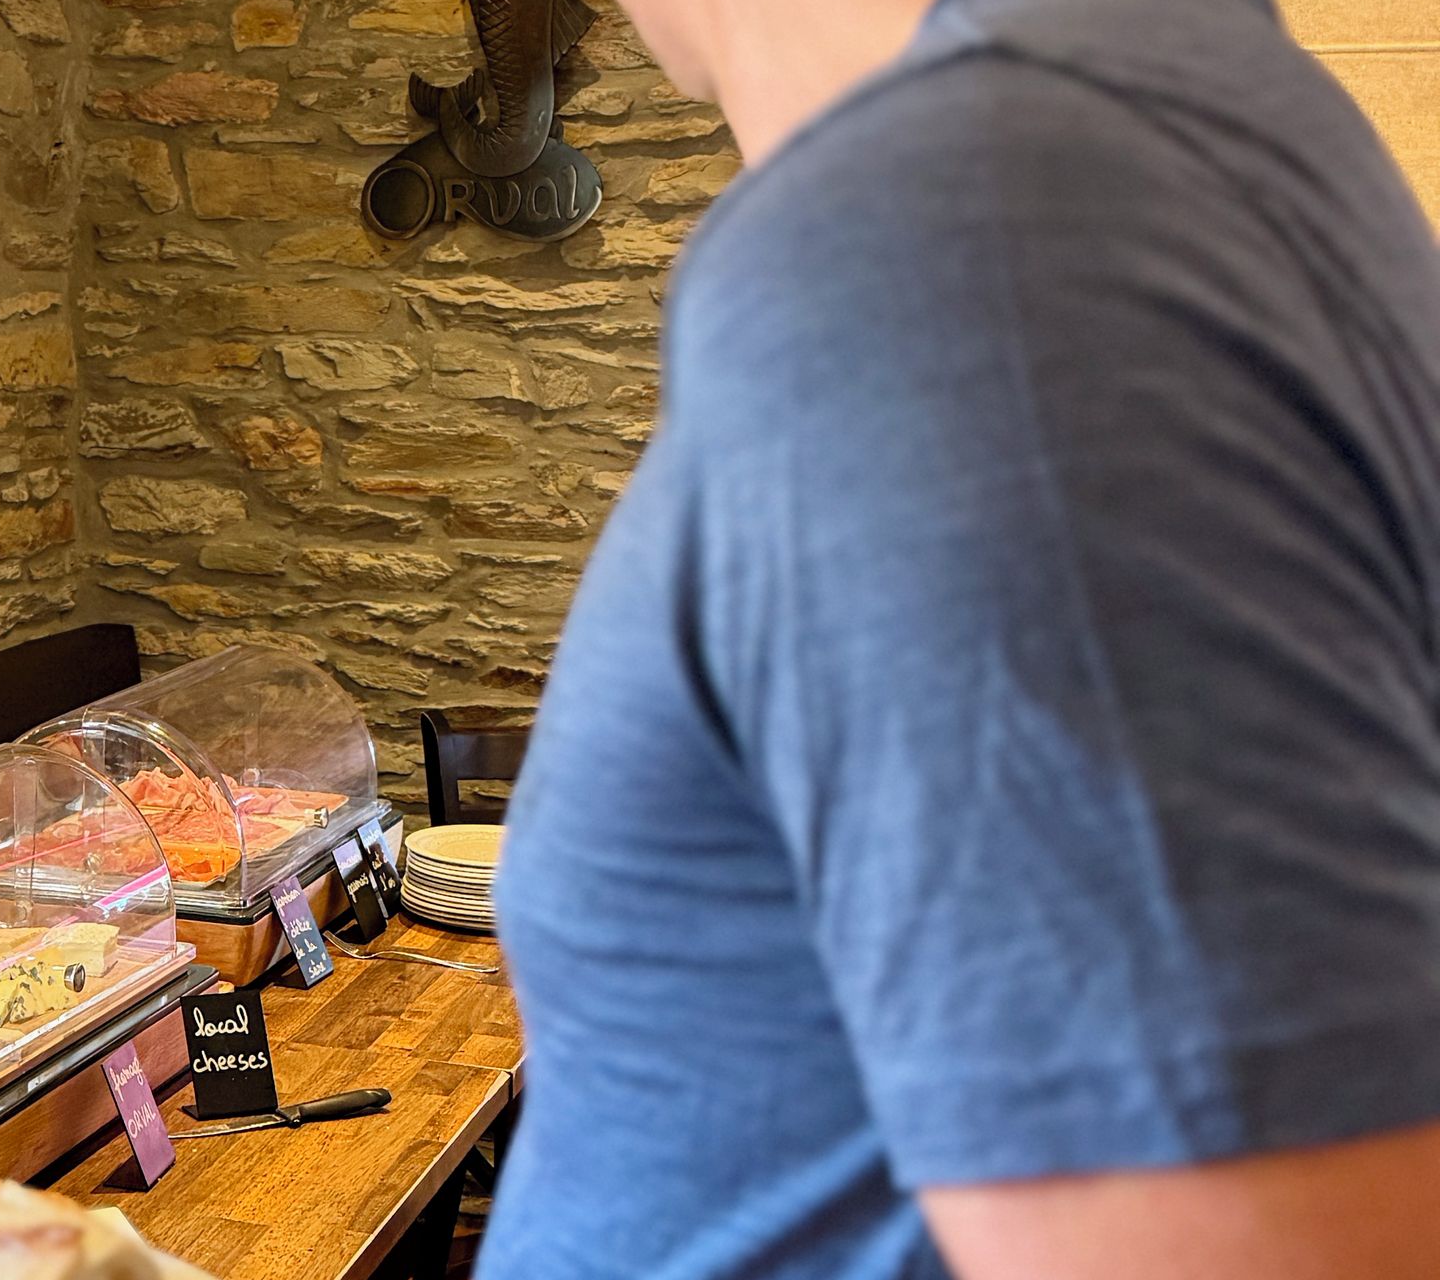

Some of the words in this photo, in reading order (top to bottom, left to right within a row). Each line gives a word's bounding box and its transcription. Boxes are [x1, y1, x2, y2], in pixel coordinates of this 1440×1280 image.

[193, 1004, 249, 1037] local
[193, 1050, 268, 1073] cheeses
[127, 1101, 156, 1139] ORVAL
